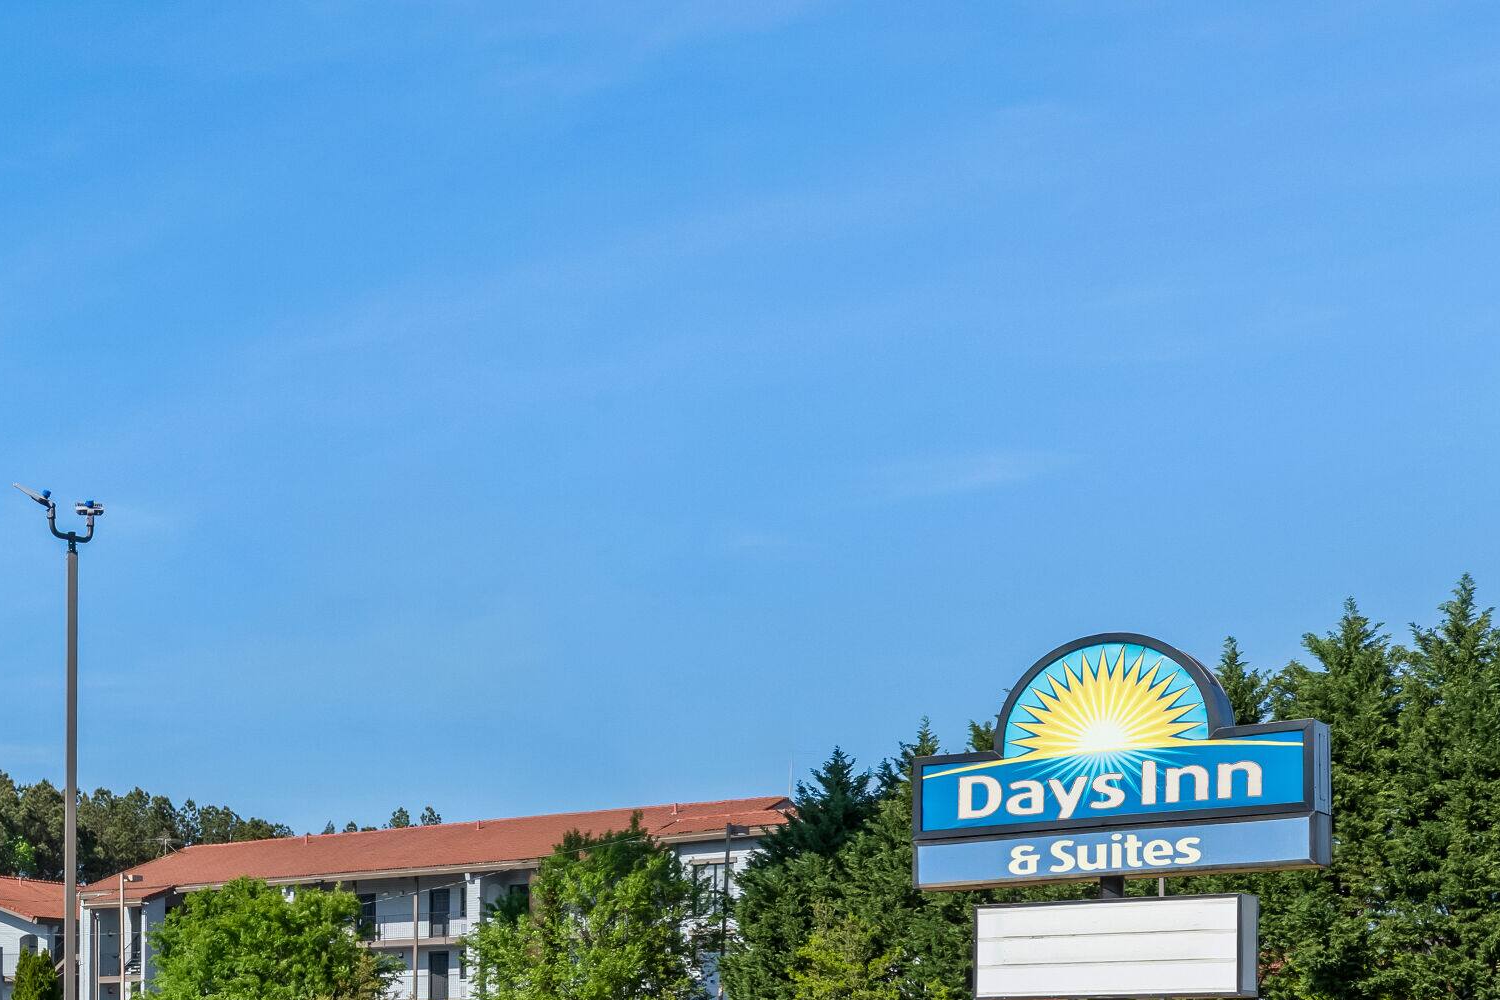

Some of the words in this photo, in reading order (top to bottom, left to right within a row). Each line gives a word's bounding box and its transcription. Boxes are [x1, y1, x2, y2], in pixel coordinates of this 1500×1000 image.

[956, 771, 1126, 821] Days
[1140, 759, 1264, 806] Inn
[1007, 843, 1041, 876] &
[1049, 833, 1203, 874] Suites
